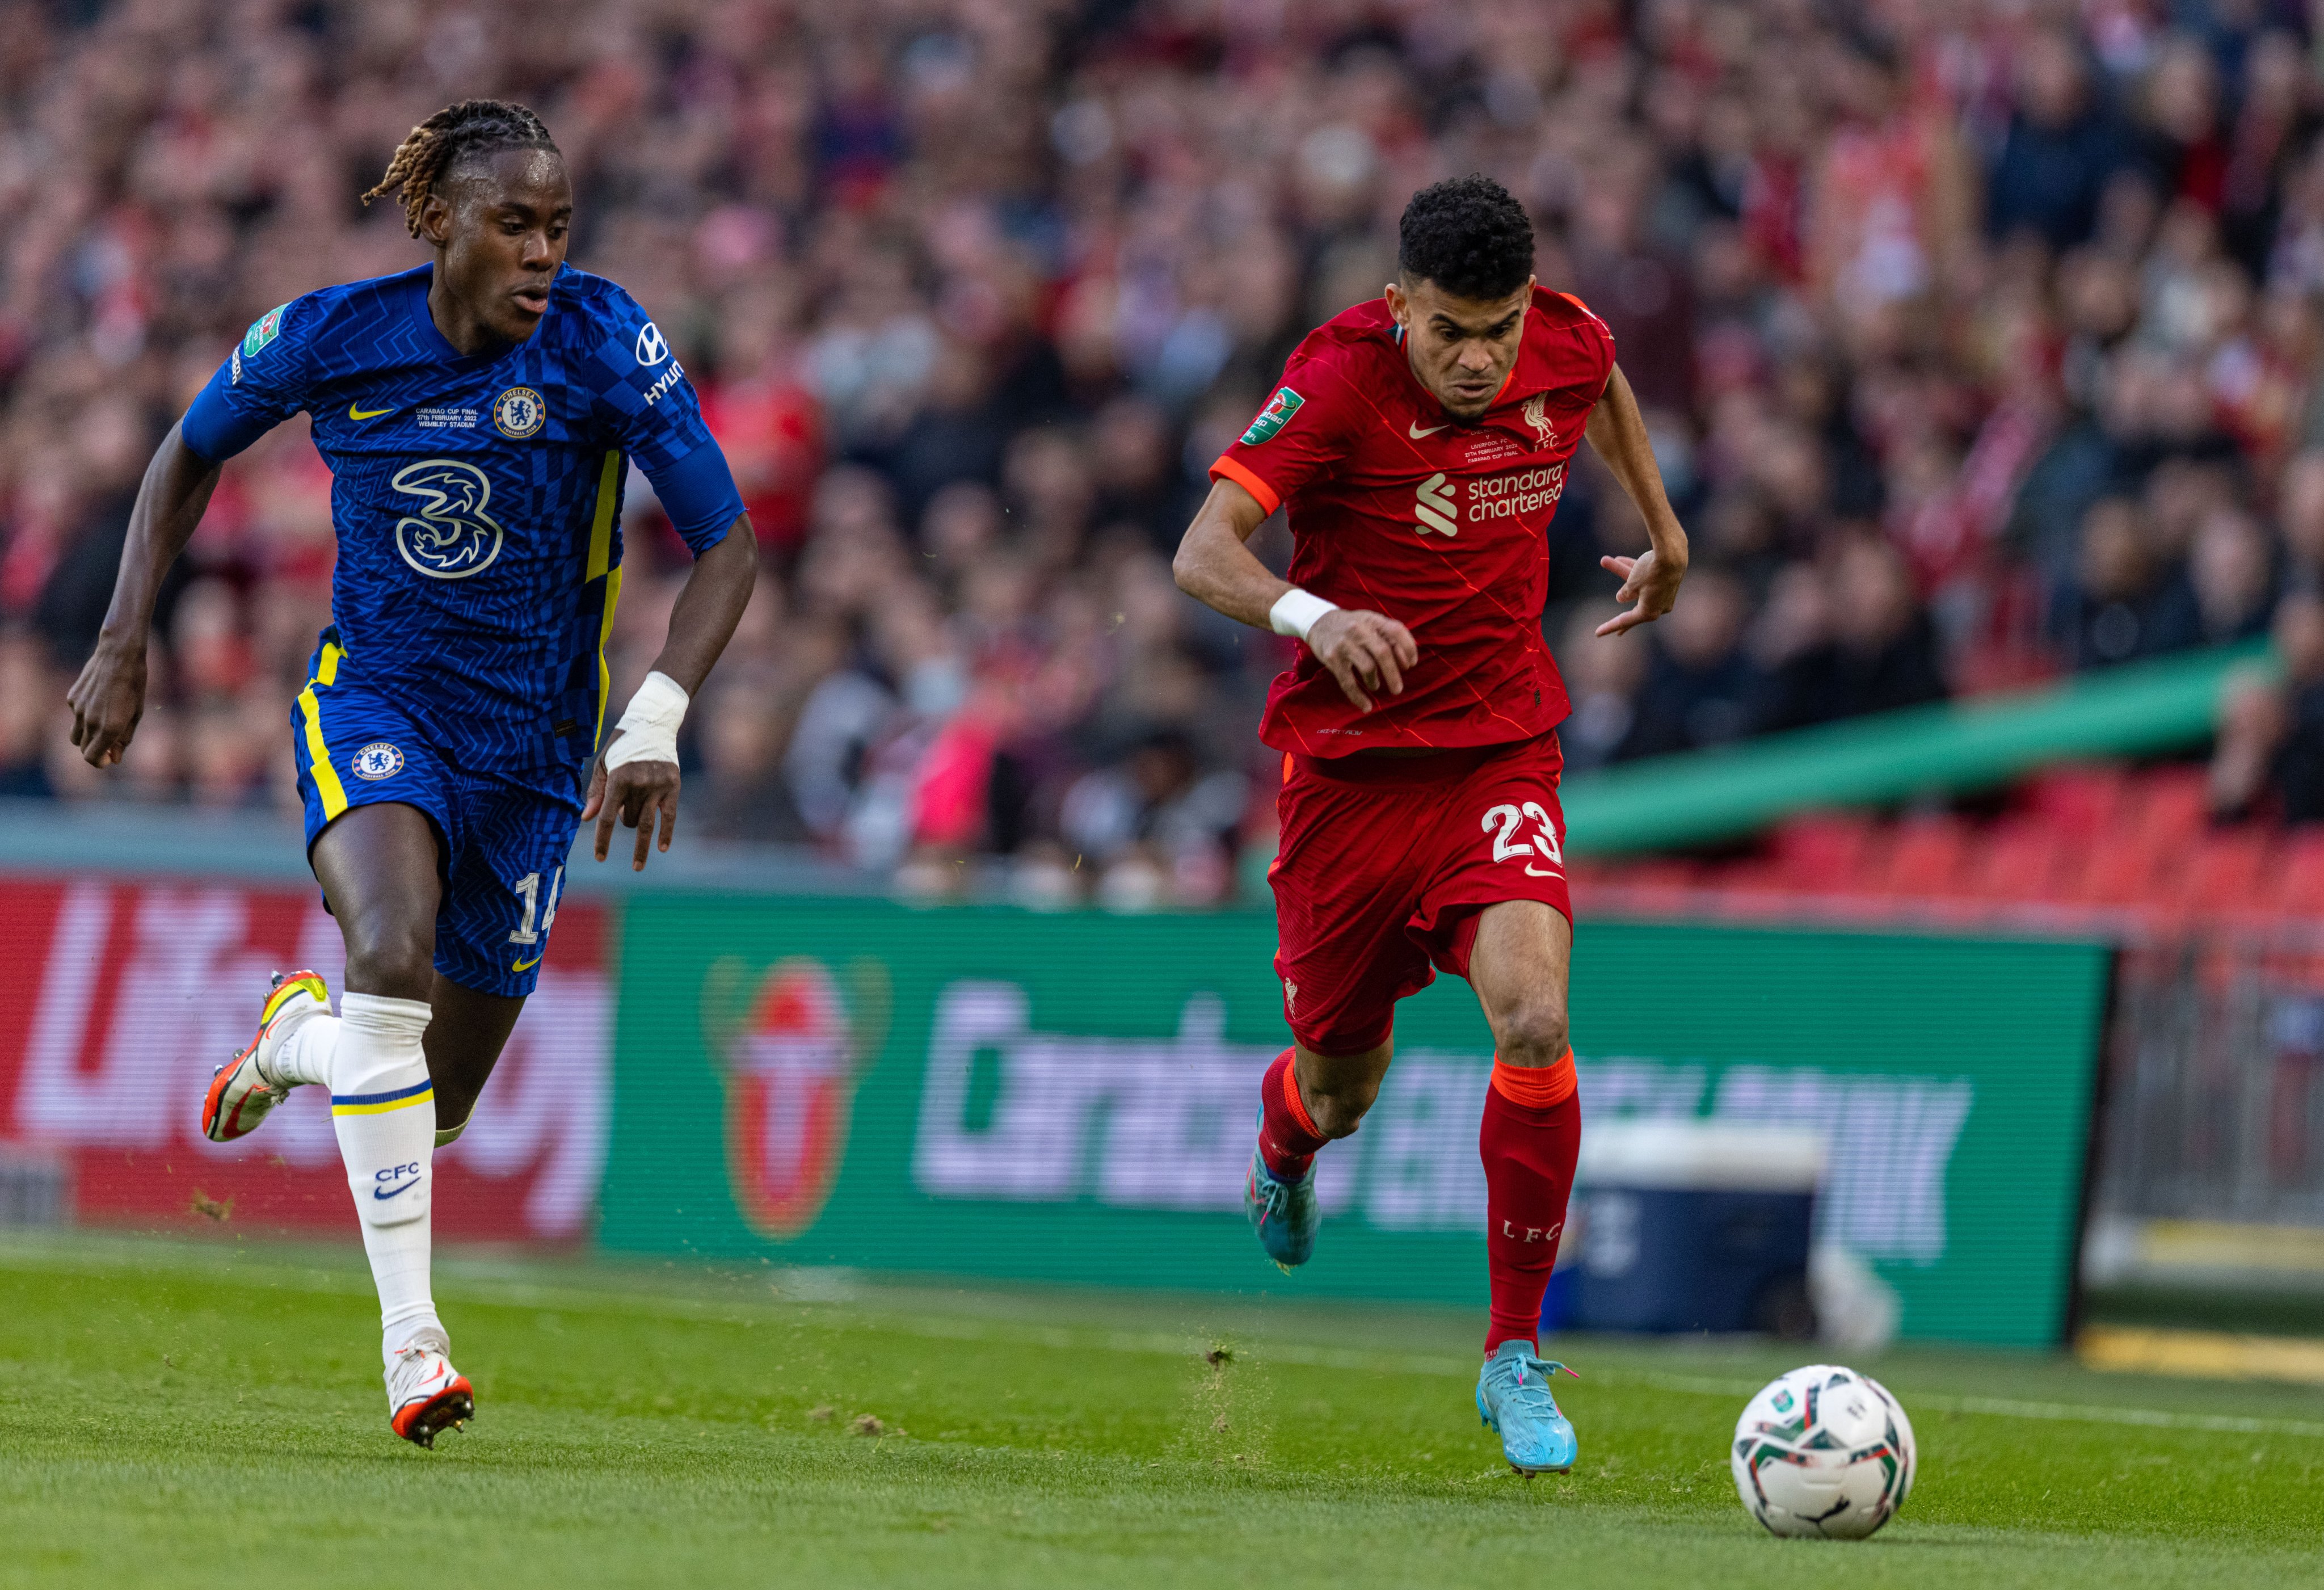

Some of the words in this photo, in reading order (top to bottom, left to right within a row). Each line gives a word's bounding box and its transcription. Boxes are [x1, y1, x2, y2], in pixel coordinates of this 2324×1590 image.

[643, 360, 684, 406] HYUN
[503, 389, 535, 401] CHELSEA
[503, 427, 525, 435] FOOTBALL
[526, 424, 537, 434] CLUB
[1471, 440, 1498, 450] LIVERPOOL
[1478, 446, 1503, 455] FEBRUARY
[1468, 460, 1566, 500] standard
[1469, 478, 1563, 522] chartered
[360, 744, 393, 755] CHELSEA
[1481, 801, 1563, 868] 23
[375, 1162, 419, 1182] CFC
[1503, 1219, 1561, 1243] LFC
